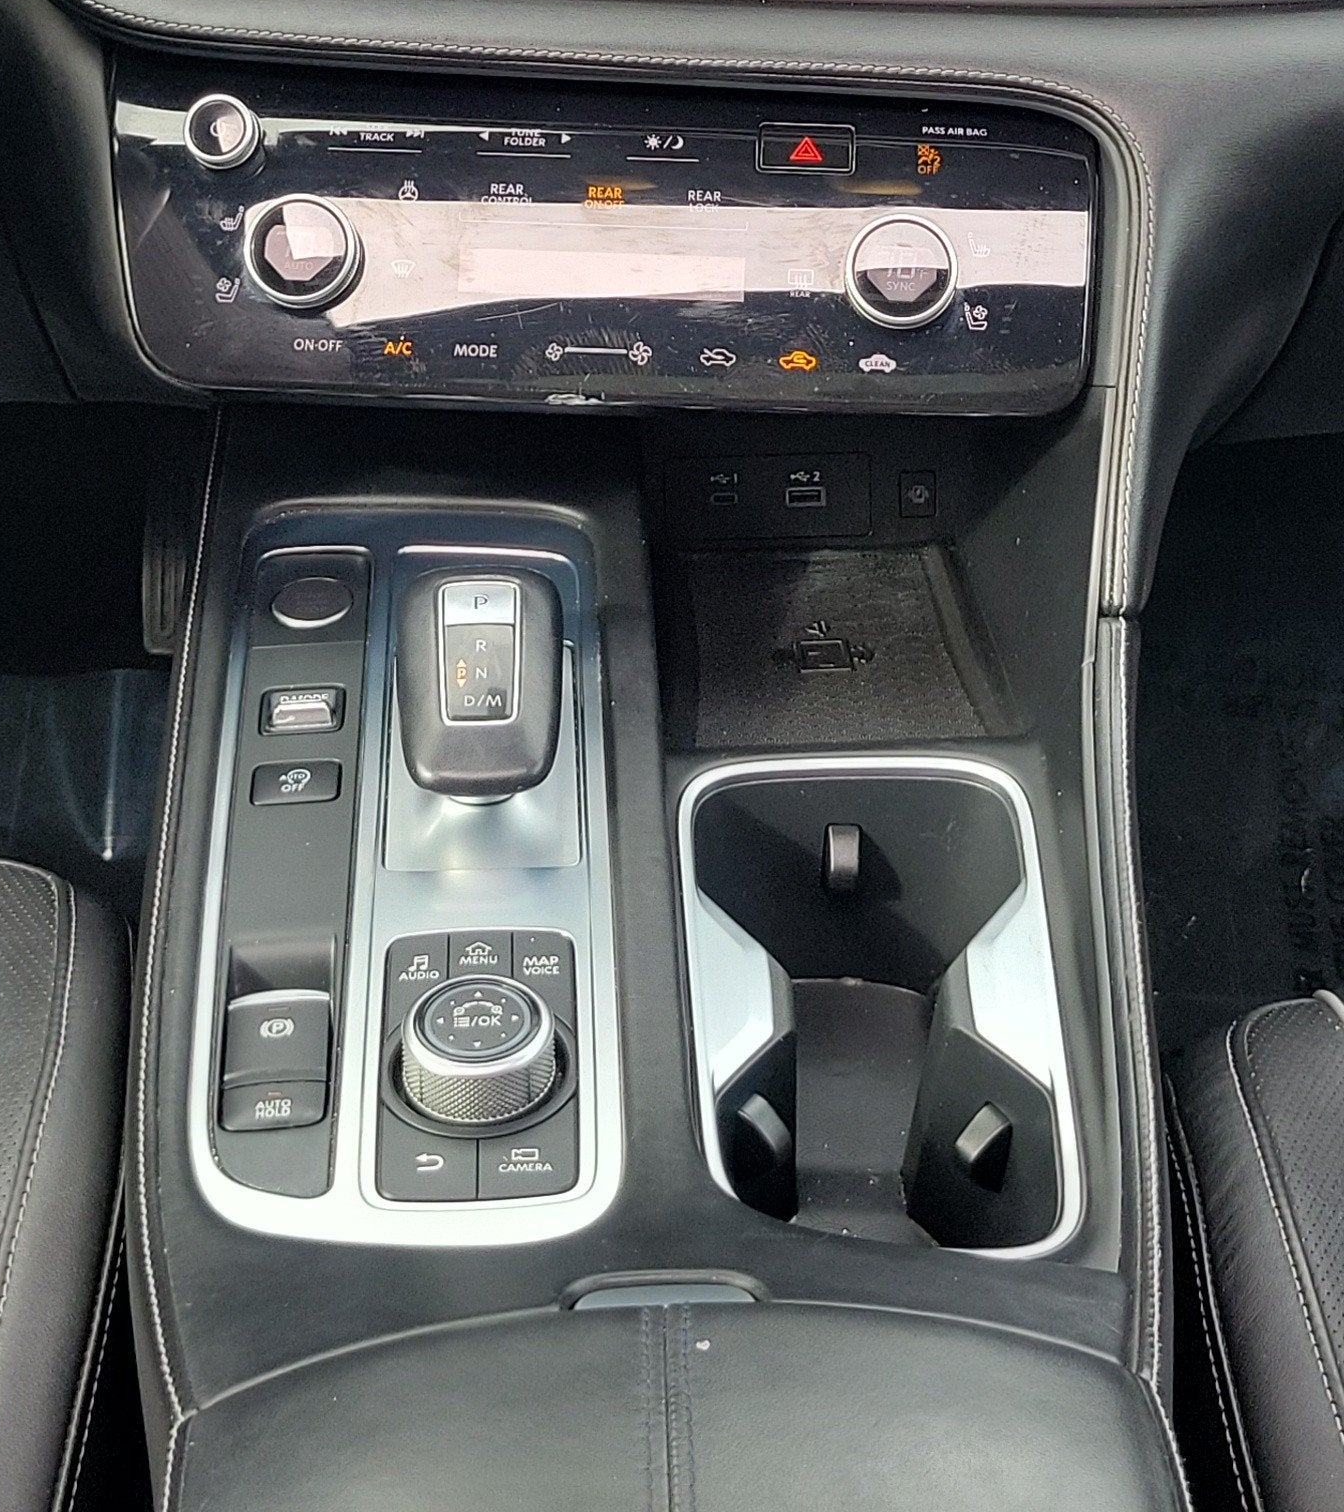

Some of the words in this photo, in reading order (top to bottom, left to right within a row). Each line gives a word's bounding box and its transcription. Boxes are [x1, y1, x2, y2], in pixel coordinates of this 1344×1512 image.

[359, 132, 394, 142] TRACK
[921, 126, 945, 136] PASS
[946, 126, 964, 136] AIR
[965, 126, 988, 137] BAG
[503, 137, 547, 148] FOLDER
[917, 165, 940, 176] OFF
[489, 183, 524, 196] REAR
[588, 186, 623, 199] REAR
[687, 190, 722, 203] REAR
[886, 281, 916, 291] SYNC
[789, 290, 811, 299] REAR
[384, 340, 413, 357] A/C
[453, 344, 499, 358] MODE
[864, 359, 892, 370] CLEAN
[473, 595, 488, 610] P
[476, 639, 487, 652] R
[475, 666, 488, 679] N
[463, 693, 503, 707] D/M
[281, 782, 306, 793] OFF
[459, 954, 498, 966] MENU
[522, 955, 560, 966] MAP
[398, 969, 440, 982] AUDIO
[522, 965, 560, 976] VOICE
[255, 1099, 292, 1109] AUTO
[255, 1108, 291, 1119] HOLD
[498, 1162, 553, 1173] CAMERA
